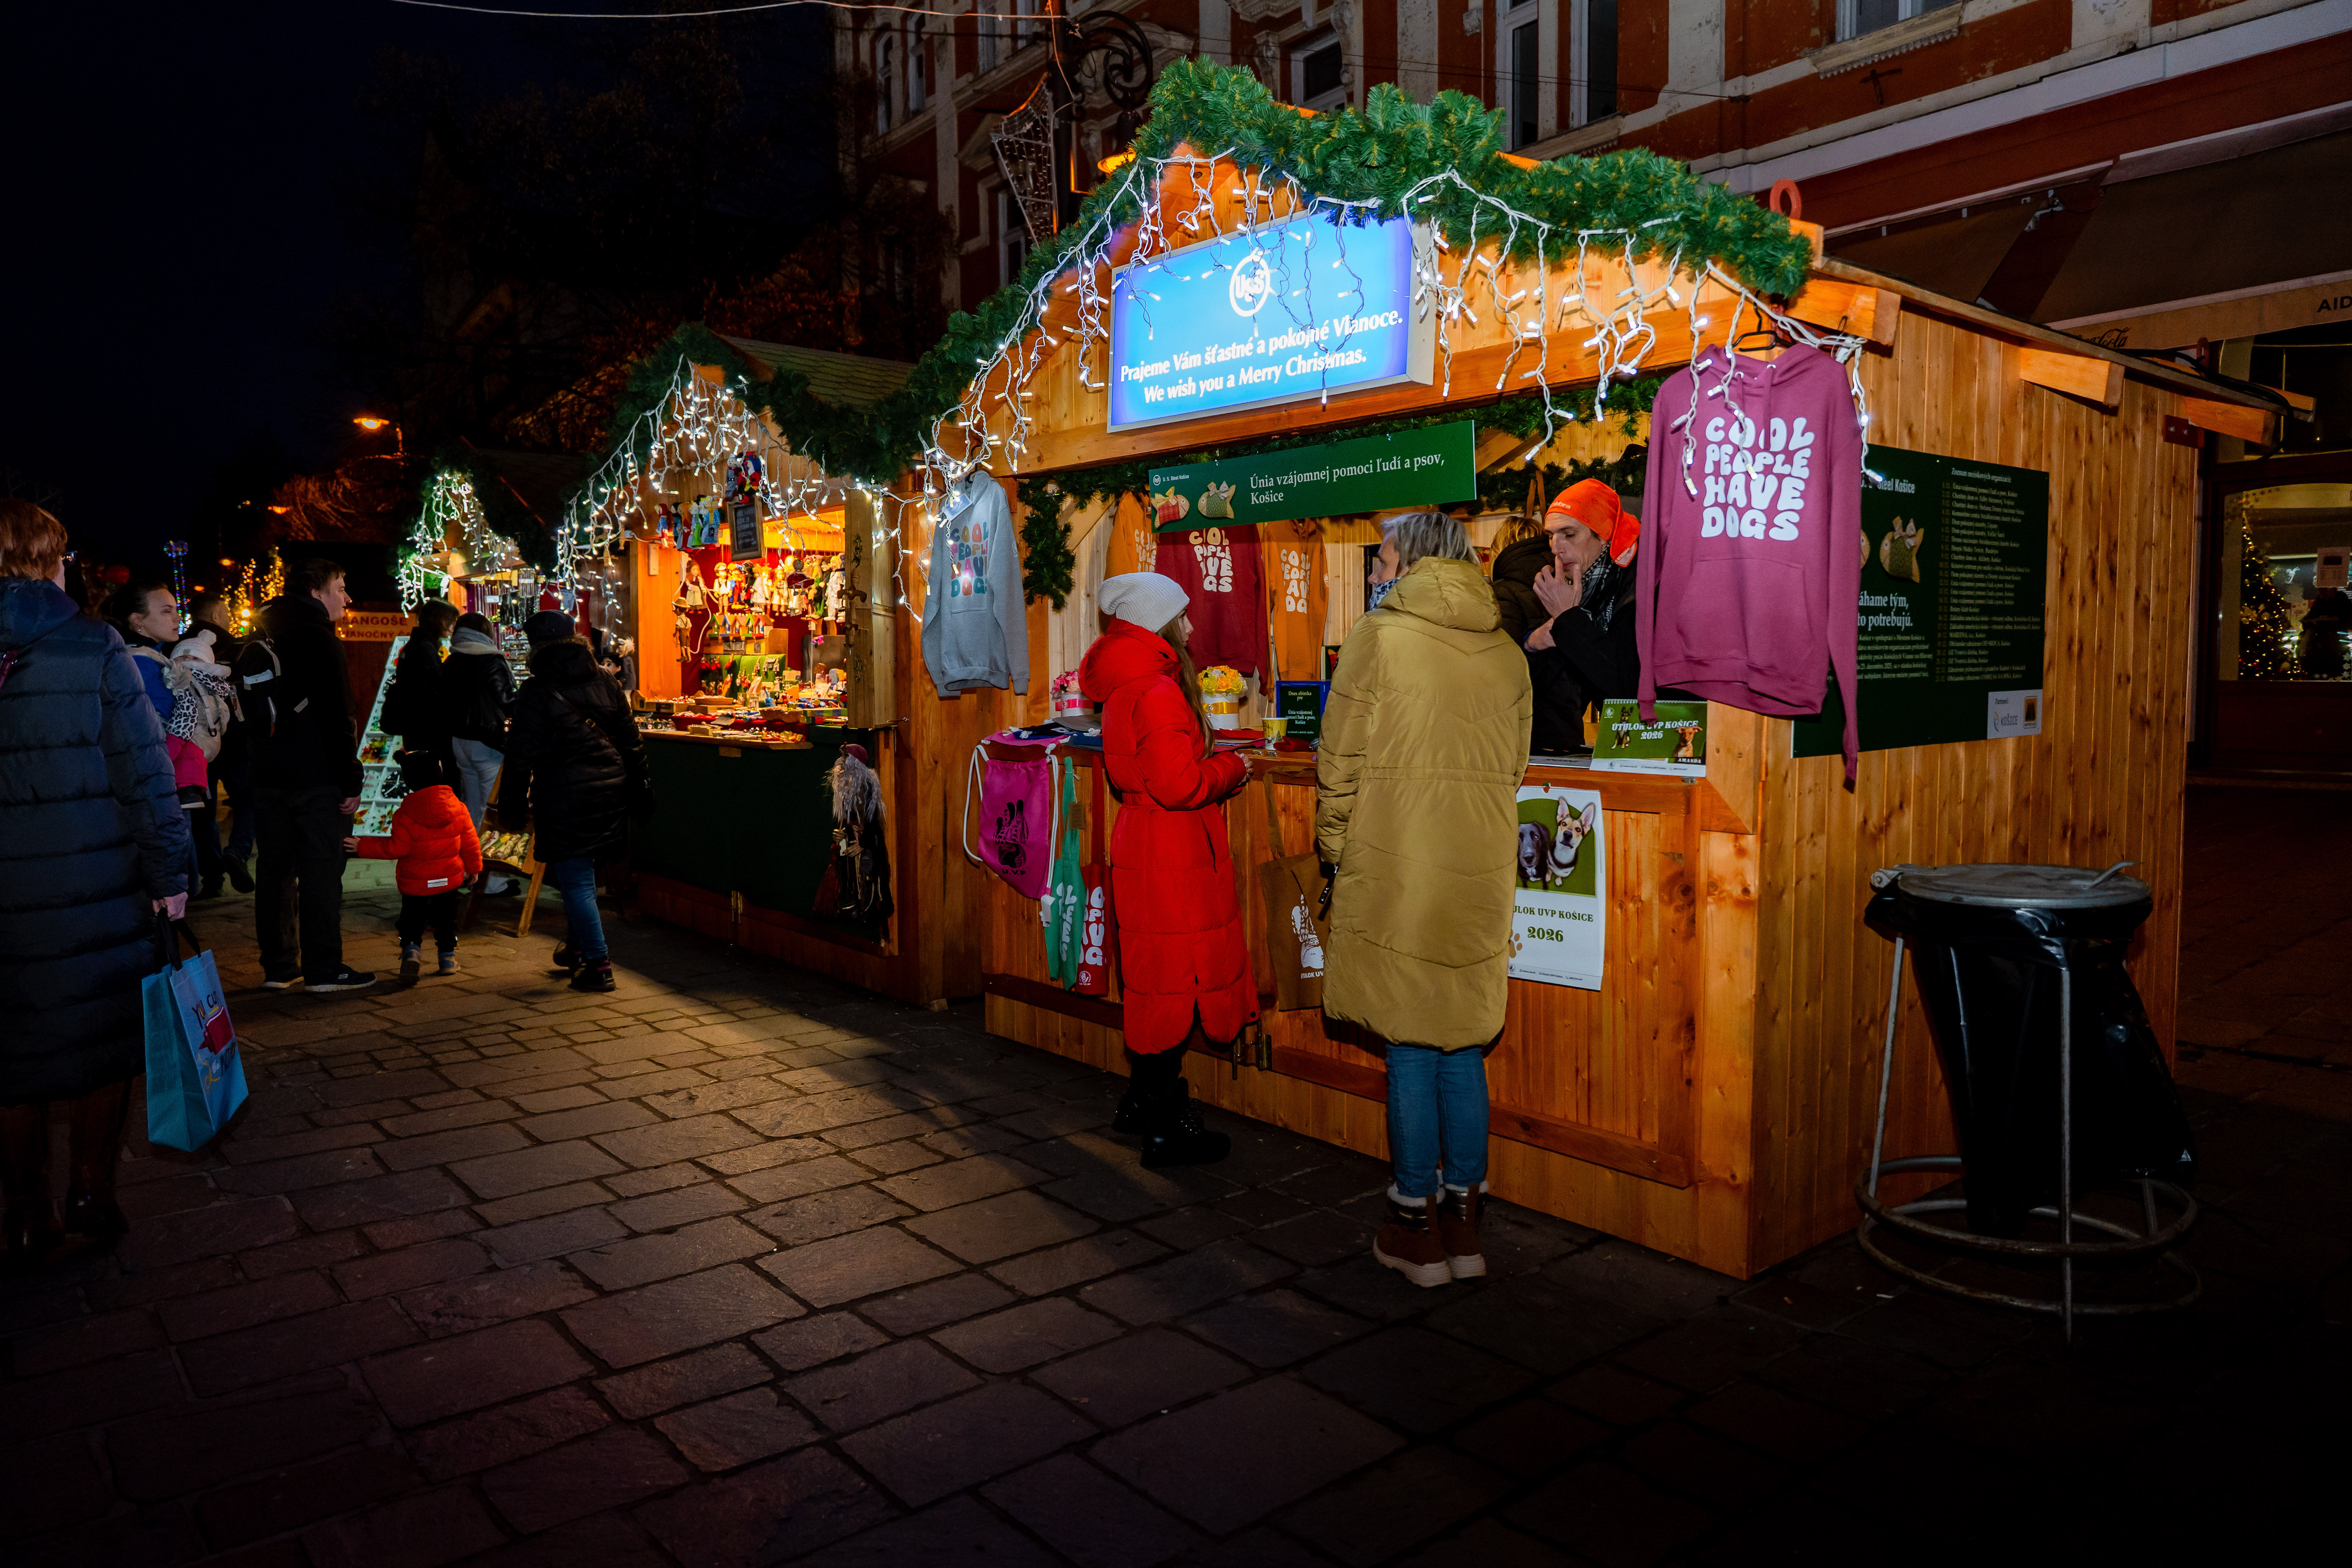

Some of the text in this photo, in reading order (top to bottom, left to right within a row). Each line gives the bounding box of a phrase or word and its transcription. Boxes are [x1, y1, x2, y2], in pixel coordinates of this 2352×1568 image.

[1121, 310, 1403, 383] Prajeme Vám šťastné a pokojné Vianoce.
[1144, 348, 1367, 403] We wish you a Merry Christmas.
[1705, 416, 1815, 452] COOL
[1250, 453, 1445, 488] Únia vzájomnej pomoci ľudí a psov,
[1704, 443, 1812, 479] PEOPLE
[1703, 473, 1806, 511] HAVE
[1895, 479, 1915, 494] Košice
[1251, 490, 1284, 505] Košice
[1701, 506, 1800, 541] DOGS
[1889, 592, 1909, 612] tým,
[1867, 612, 1913, 631] potrebujú.
[1612, 722, 1645, 731] ÚTULOK
[1664, 720, 1699, 729] KOŠICE
[1641, 731, 1664, 740] 2026
[1538, 908, 1556, 918] UVP
[1559, 910, 1593, 922] KOŠICE
[1527, 926, 1564, 942] 2026
